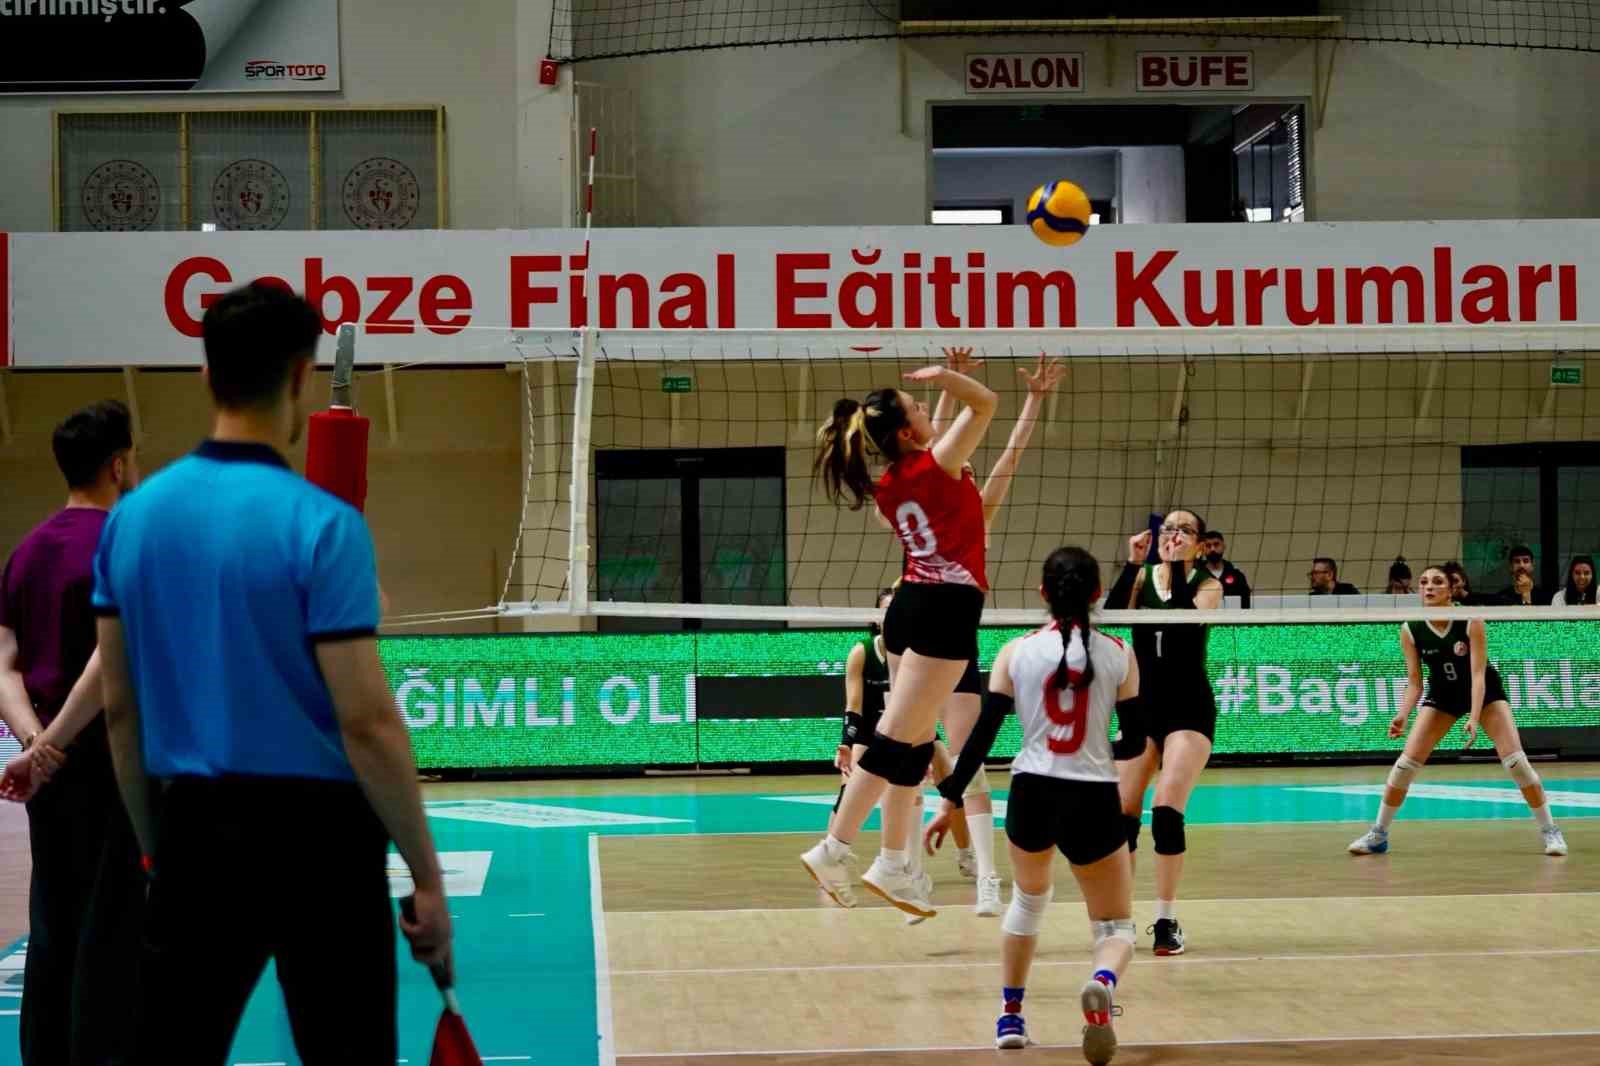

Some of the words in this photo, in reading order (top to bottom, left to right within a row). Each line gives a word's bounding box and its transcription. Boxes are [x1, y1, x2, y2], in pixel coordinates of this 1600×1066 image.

[969, 58, 1079, 88] SALON
[1142, 56, 1249, 87] BÜFE
[164, 256, 473, 338] Gbze
[510, 253, 736, 328] Final
[775, 249, 1077, 352] Eğitim
[1115, 247, 1577, 328] Kurumları
[1443, 662, 1458, 681] 9
[1044, 667, 1090, 754] 9
